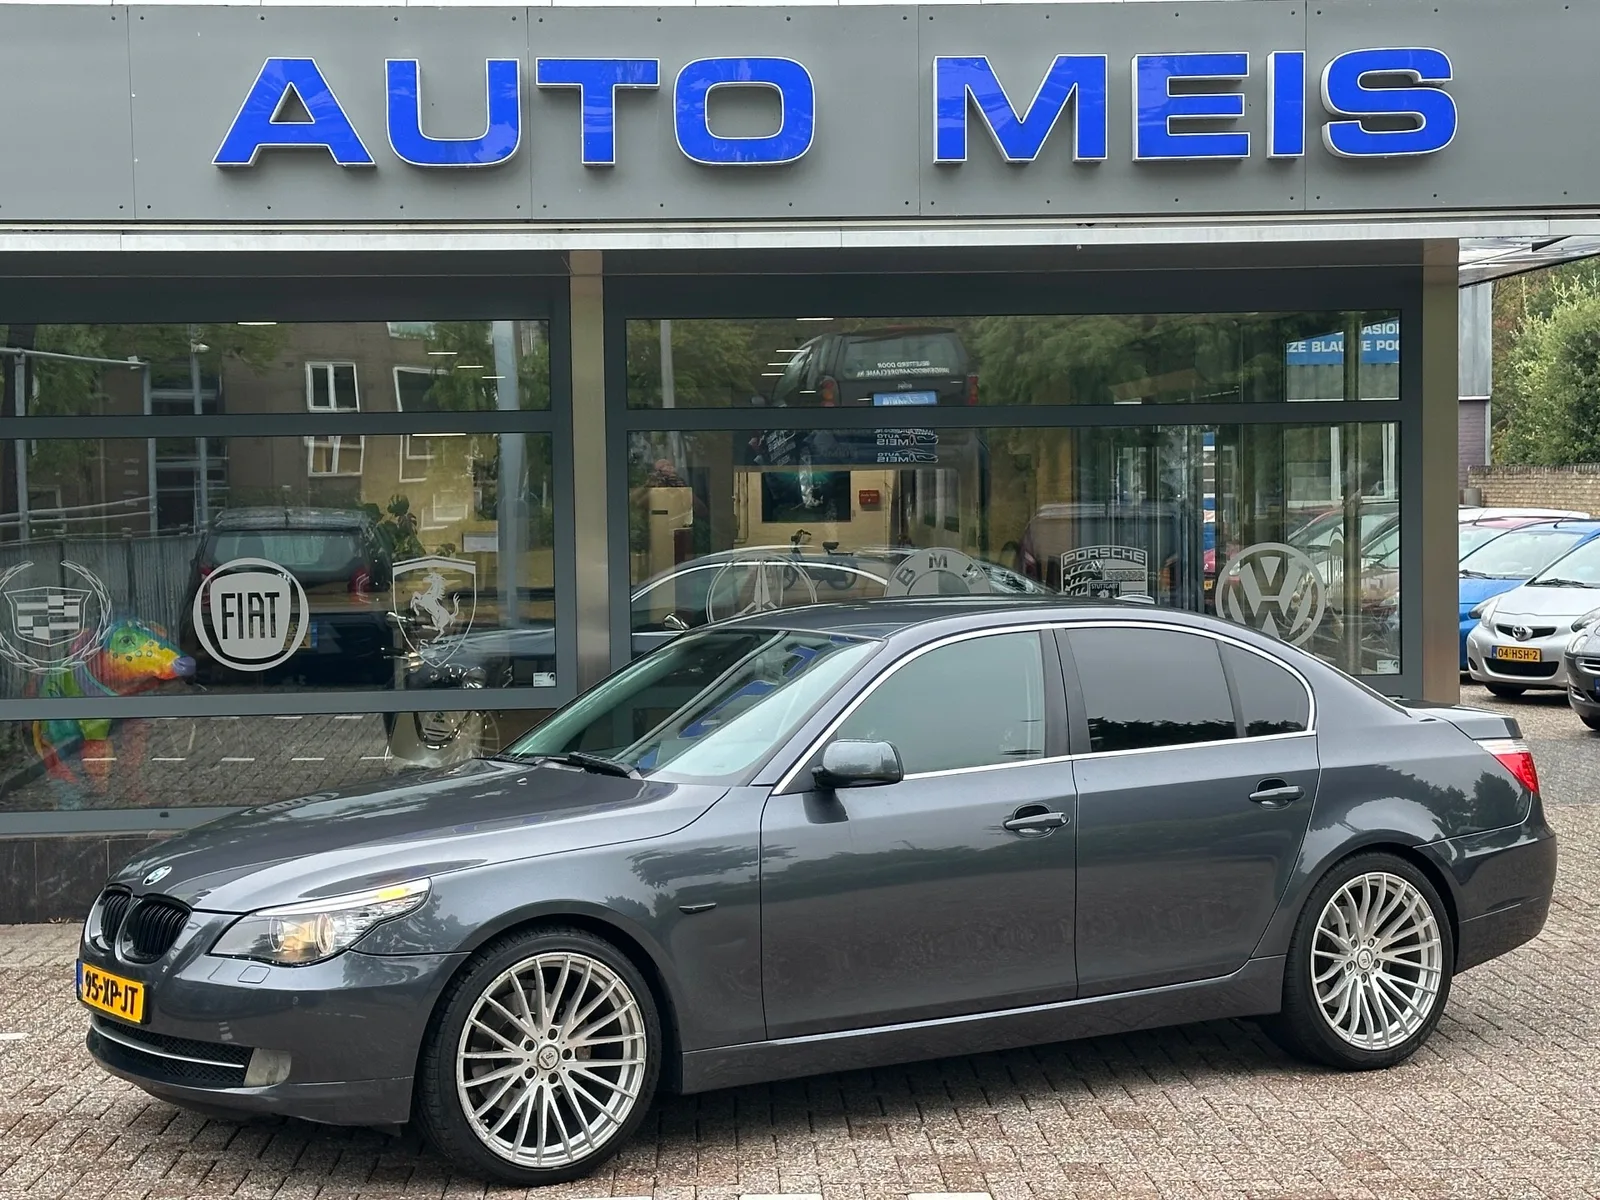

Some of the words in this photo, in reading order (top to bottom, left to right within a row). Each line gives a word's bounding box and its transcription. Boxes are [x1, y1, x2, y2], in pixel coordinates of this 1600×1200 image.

[211, 56, 816, 168] AUTO
[933, 47, 1458, 163] MEIS
[1064, 548, 1145, 566] PORSCHE
[221, 591, 280, 640] FIAT
[1498, 648, 1538, 660] 04-HSH-2
[85, 970, 139, 1015] 95-XP-JT
